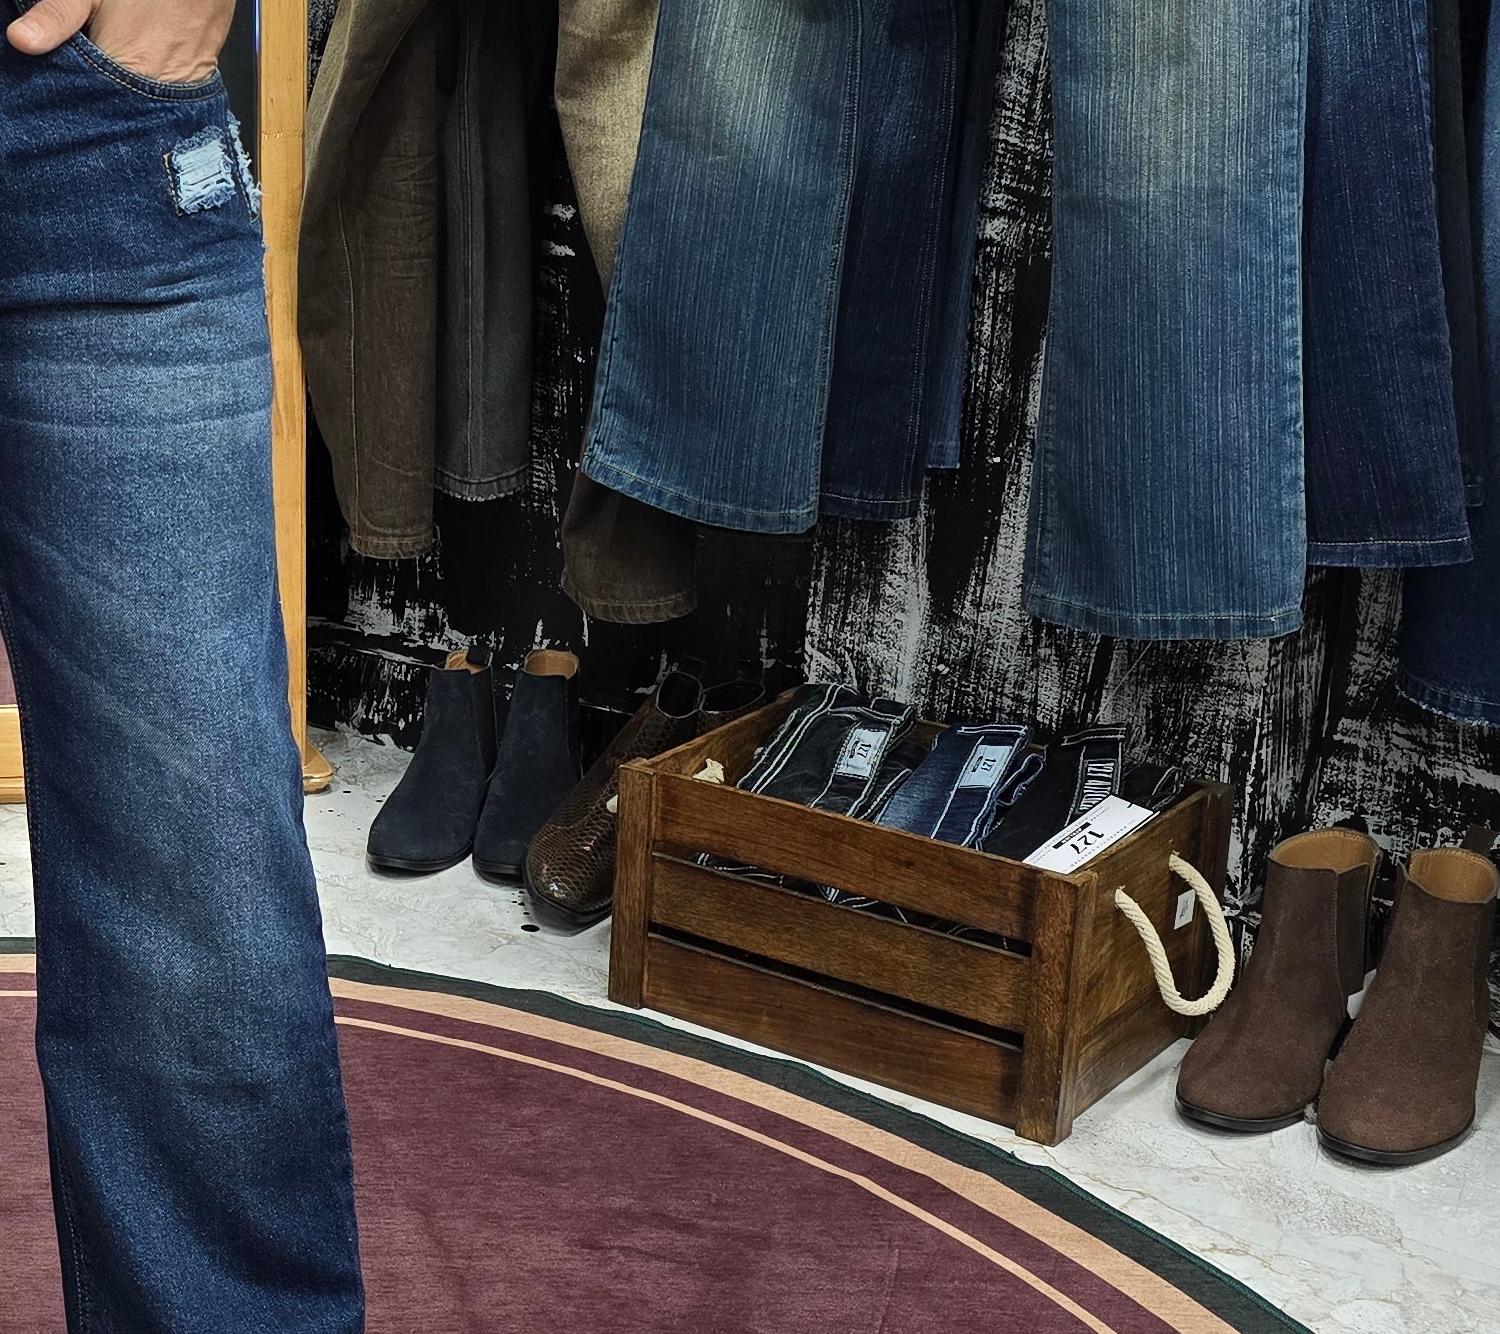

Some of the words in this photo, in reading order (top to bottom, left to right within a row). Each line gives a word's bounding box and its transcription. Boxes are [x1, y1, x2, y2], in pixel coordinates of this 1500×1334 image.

[856, 743, 872, 759] 127
[980, 758, 997, 772] 127
[1086, 762, 1115, 778] 127
[1070, 830, 1104, 855] 127
